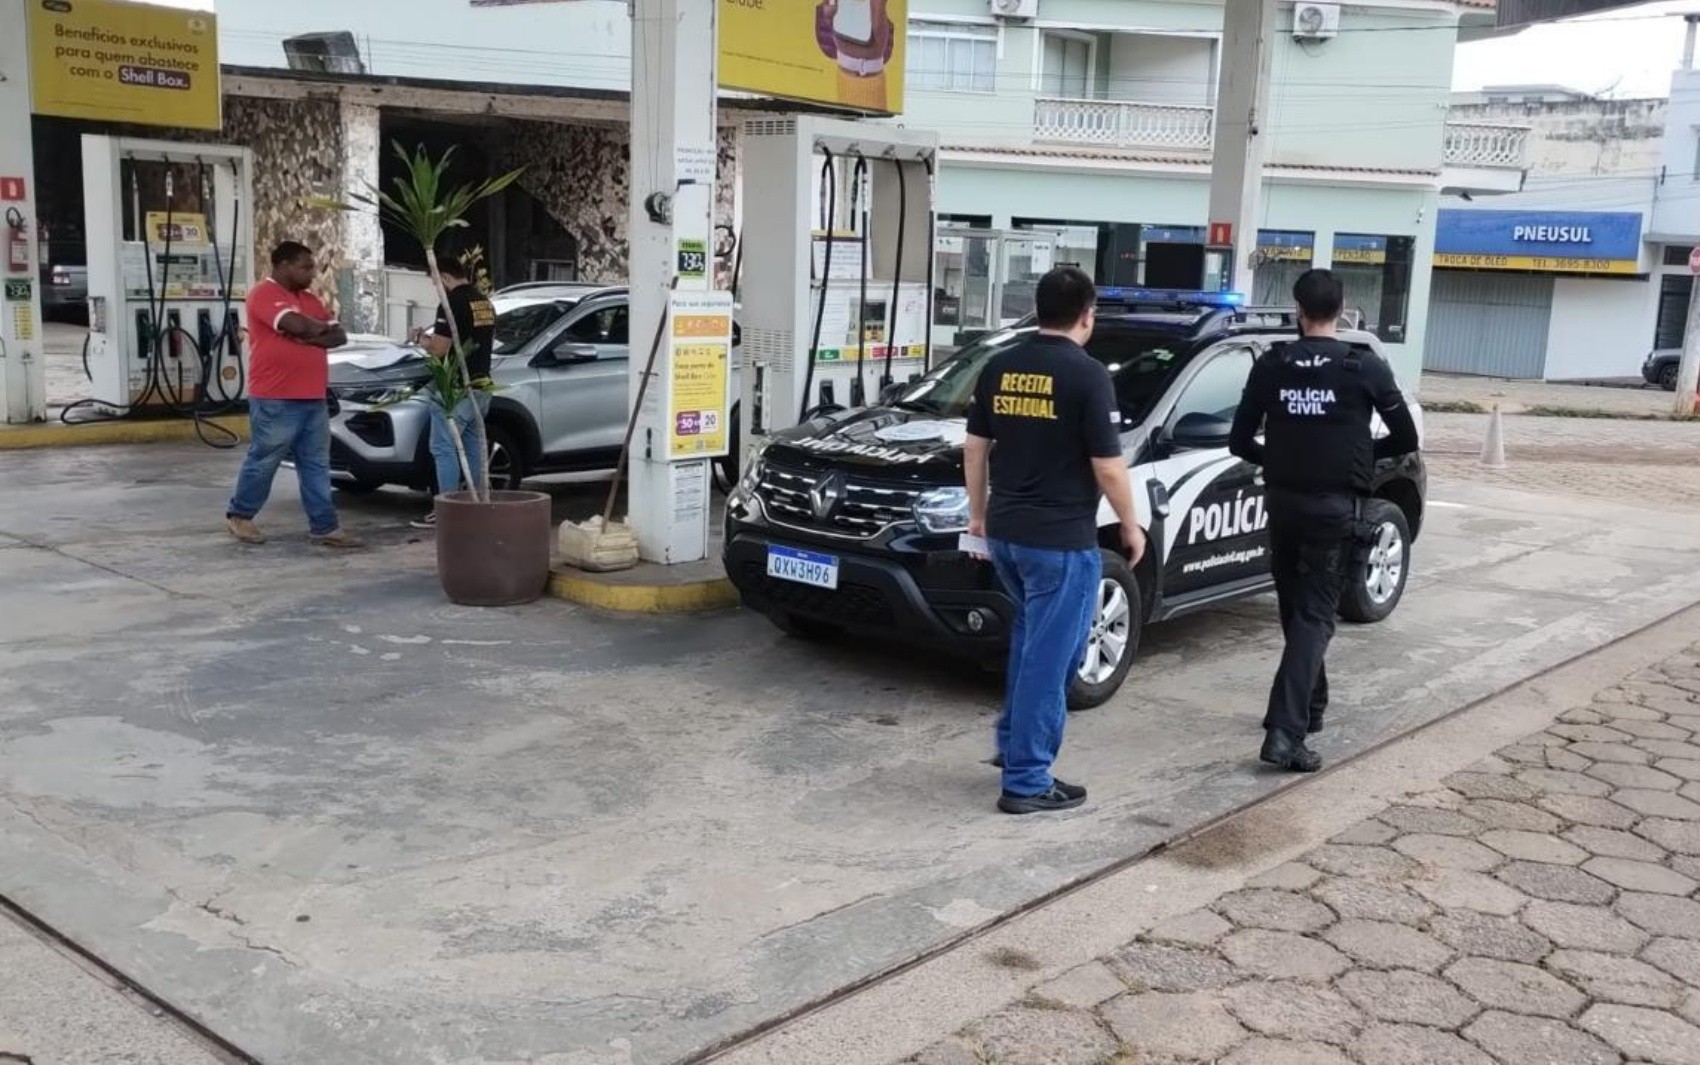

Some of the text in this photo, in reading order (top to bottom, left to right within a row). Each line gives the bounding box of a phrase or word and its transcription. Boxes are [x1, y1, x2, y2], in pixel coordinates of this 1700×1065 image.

[129, 36, 199, 55] exclusivos
[55, 45, 200, 71] para quem abastece
[69, 66, 189, 87] com o Shell Box.
[1513, 226, 1592, 244] PNEUSUL
[1439, 254, 1467, 265] TROCA
[1470, 256, 1482, 266] DE
[1001, 373, 1053, 395] RECEITA
[1280, 386, 1336, 402] POLÍCIA
[994, 395, 1058, 419] ESTADUAL
[1287, 402, 1326, 415] CIVIL
[705, 414, 716, 426] 20
[774, 557, 829, 584] QXW3H96
